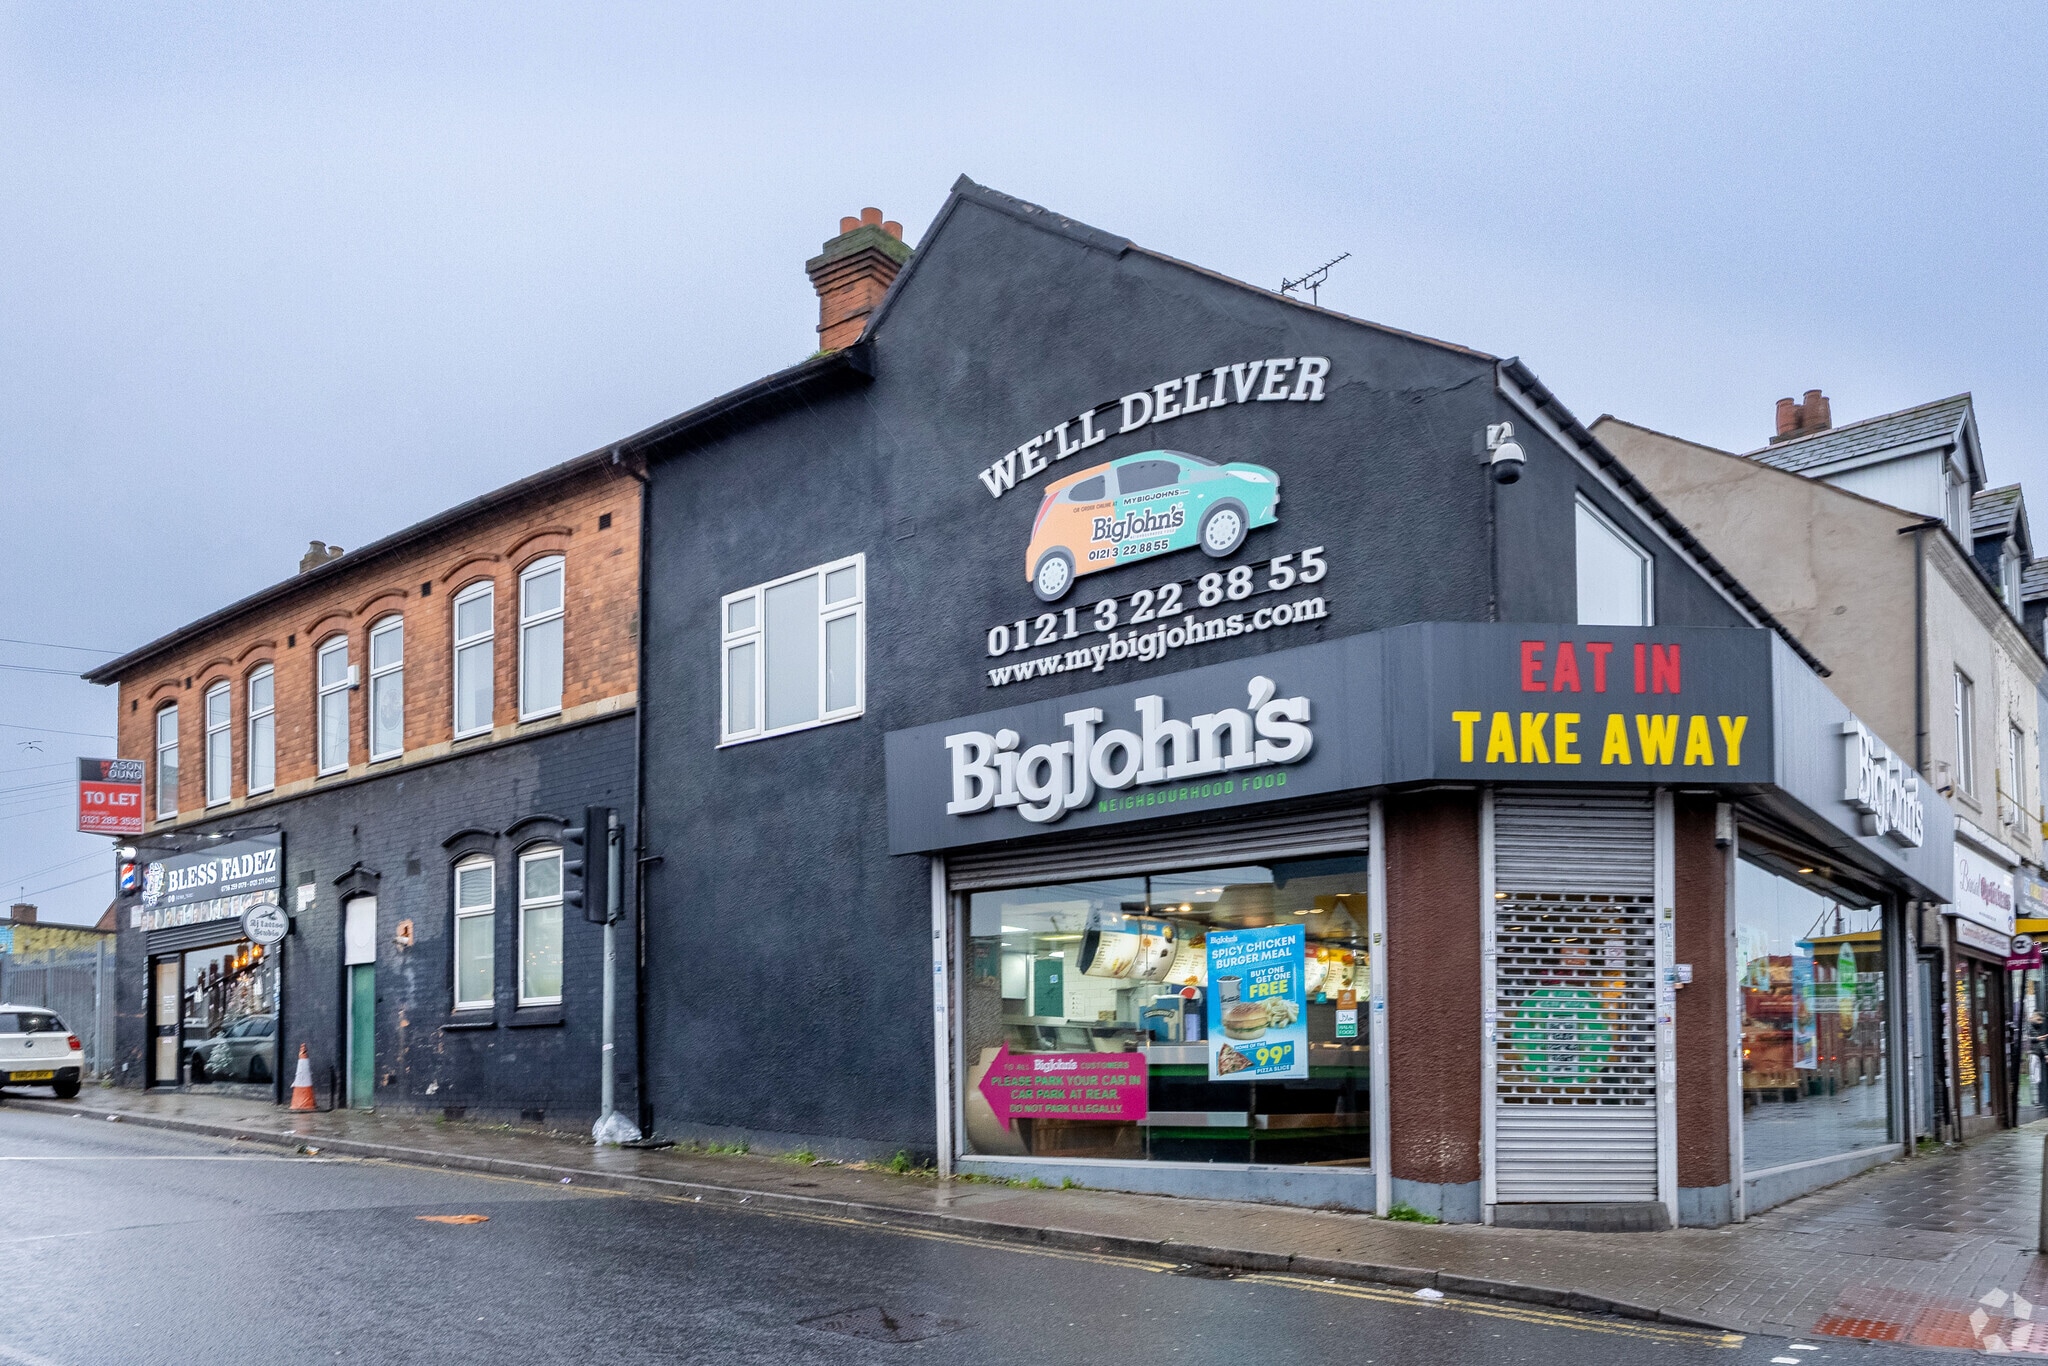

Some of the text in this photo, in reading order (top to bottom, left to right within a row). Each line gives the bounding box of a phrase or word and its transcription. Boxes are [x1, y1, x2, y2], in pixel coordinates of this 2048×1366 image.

[978, 356, 1332, 498] WE'LL DELIVER
[1081, 504, 1095, 512] ORDER
[1092, 505, 1184, 543] BigJohn's
[1088, 549, 1110, 560] 0121
[1112, 547, 1118, 557] 3
[988, 546, 1328, 657] 0121 3 22 88 55
[987, 597, 1328, 686] www.mybigjohns.com
[1521, 640, 1681, 694] EAT IN
[1452, 711, 1748, 766] TAKE AWAY
[945, 675, 1314, 823] BigJohn's
[103, 769, 142, 779] YOUNG
[83, 790, 139, 807] TO LET
[1098, 771, 1287, 813] NEIGHBOURHOOD FOOD
[168, 849, 277, 893] BLESS FADEZ
[1980, 876, 2011, 912] Opticians
[1210, 935, 1238, 945] BigJohn's
[1212, 935, 1296, 959] SPICY CHICKEN
[1216, 952, 1259, 969] BURGER
[1261, 947, 1292, 961] MEAL
[1250, 966, 1285, 978] BUY ONE
[1255, 971, 1291, 984] GET ONE
[1249, 979, 1288, 998] FREE
[1033, 1059, 1078, 1073] BigJohn's
[1256, 1066, 1273, 1074] PIZZA
[991, 1075, 1141, 1086] PLEASE PARK YOUR CAR IN
[1010, 1089, 1033, 1099] CAR
[1036, 1089, 1065, 1099] PARK
[1069, 1089, 1082, 1099] AT
[1009, 1104, 1022, 1113] DO
[1024, 1104, 1043, 1112] NOT
[1045, 1104, 1069, 1113] PARK
